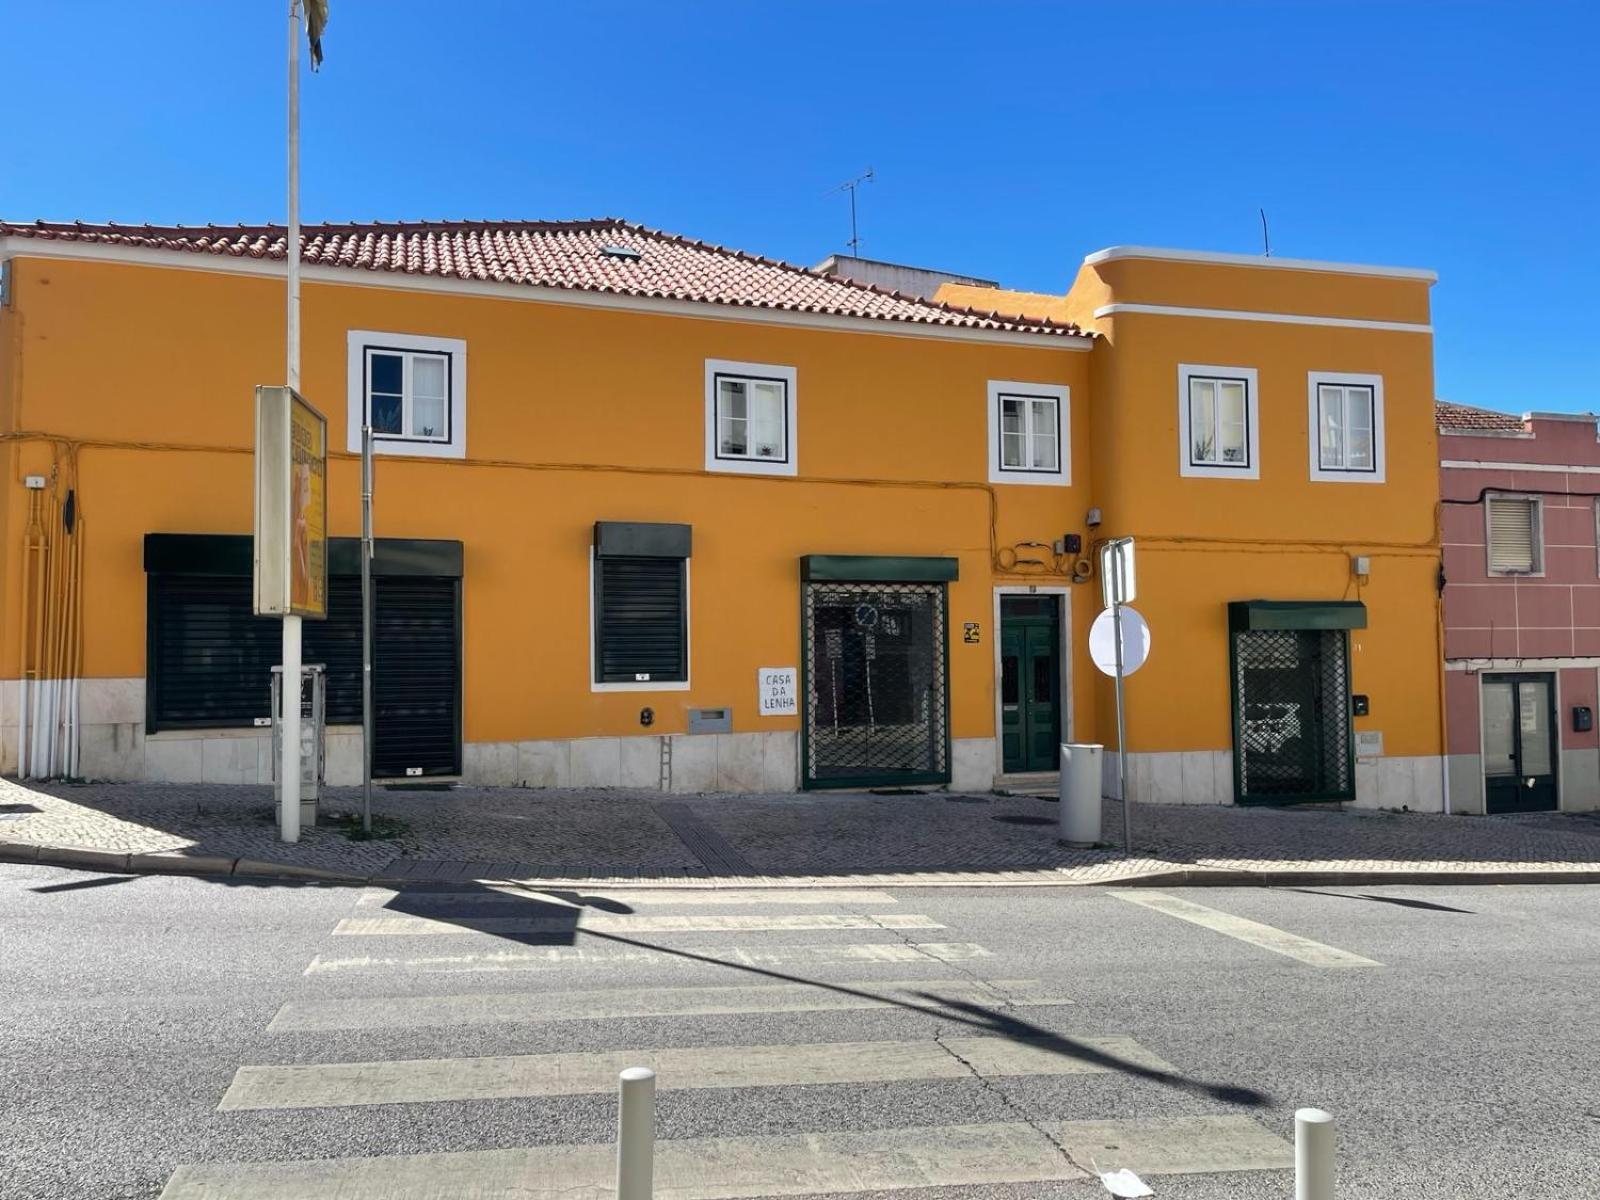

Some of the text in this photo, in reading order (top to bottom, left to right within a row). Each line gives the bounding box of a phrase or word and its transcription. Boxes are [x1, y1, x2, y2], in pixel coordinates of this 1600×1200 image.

[766, 674, 791, 685] CASA
[772, 686, 786, 697] DA
[764, 697, 795, 709] LENHA
